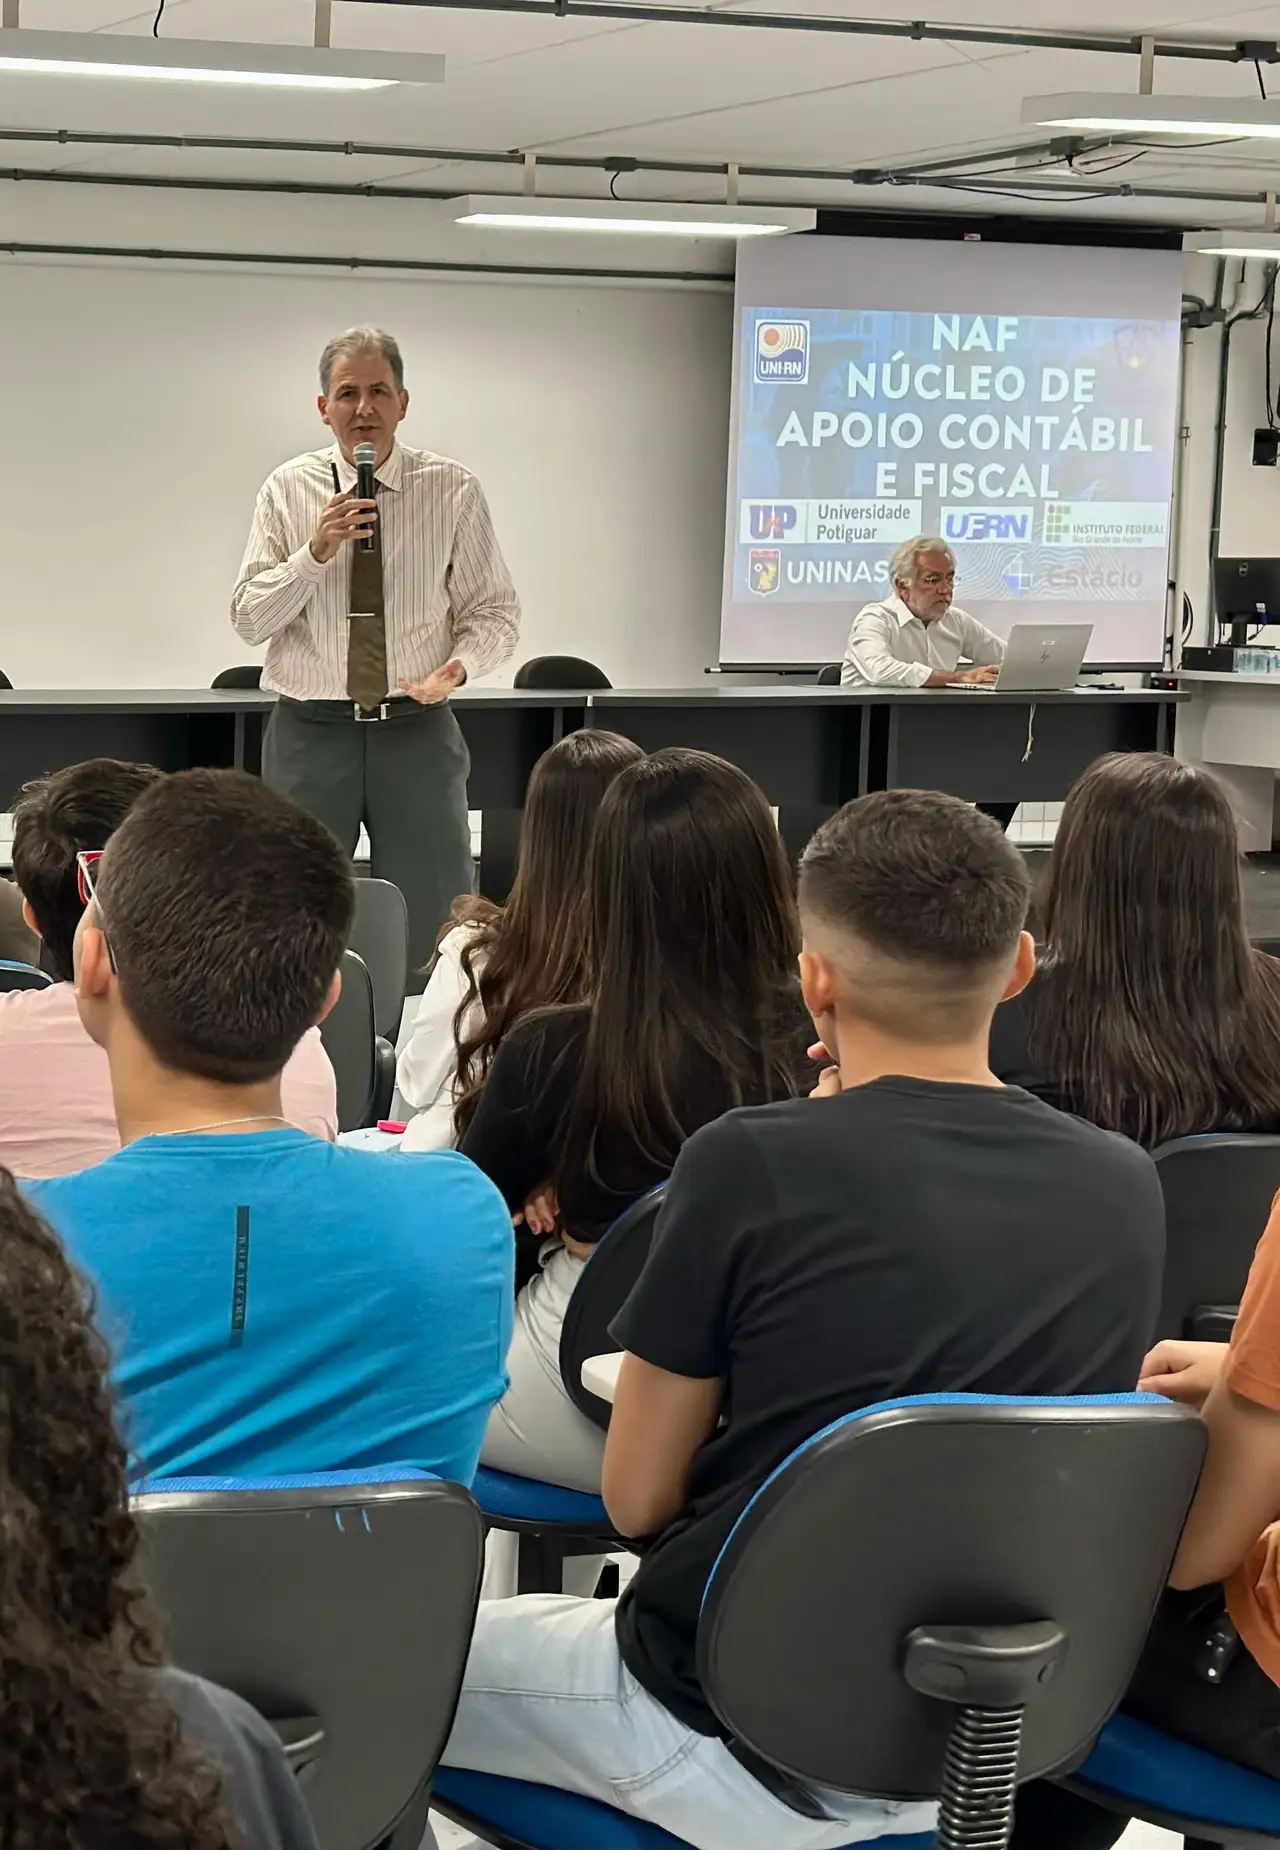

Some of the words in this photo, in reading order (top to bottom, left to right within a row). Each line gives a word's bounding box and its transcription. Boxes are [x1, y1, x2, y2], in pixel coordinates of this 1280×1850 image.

[932, 314, 1018, 352] NAF
[848, 351, 1025, 402] NÚCLEO
[1041, 368, 1096, 403] DE
[776, 410, 924, 448] APOIO
[939, 404, 1153, 452] CONTÁBIL
[876, 462, 896, 497] E
[914, 463, 1060, 499] FISCAL
[818, 504, 911, 520] Universidade
[945, 513, 1028, 540] UFRN
[817, 524, 878, 543] Potiguar
[1073, 524, 1123, 534] INSTITUTO
[1125, 524, 1164, 534] FEDERAL
